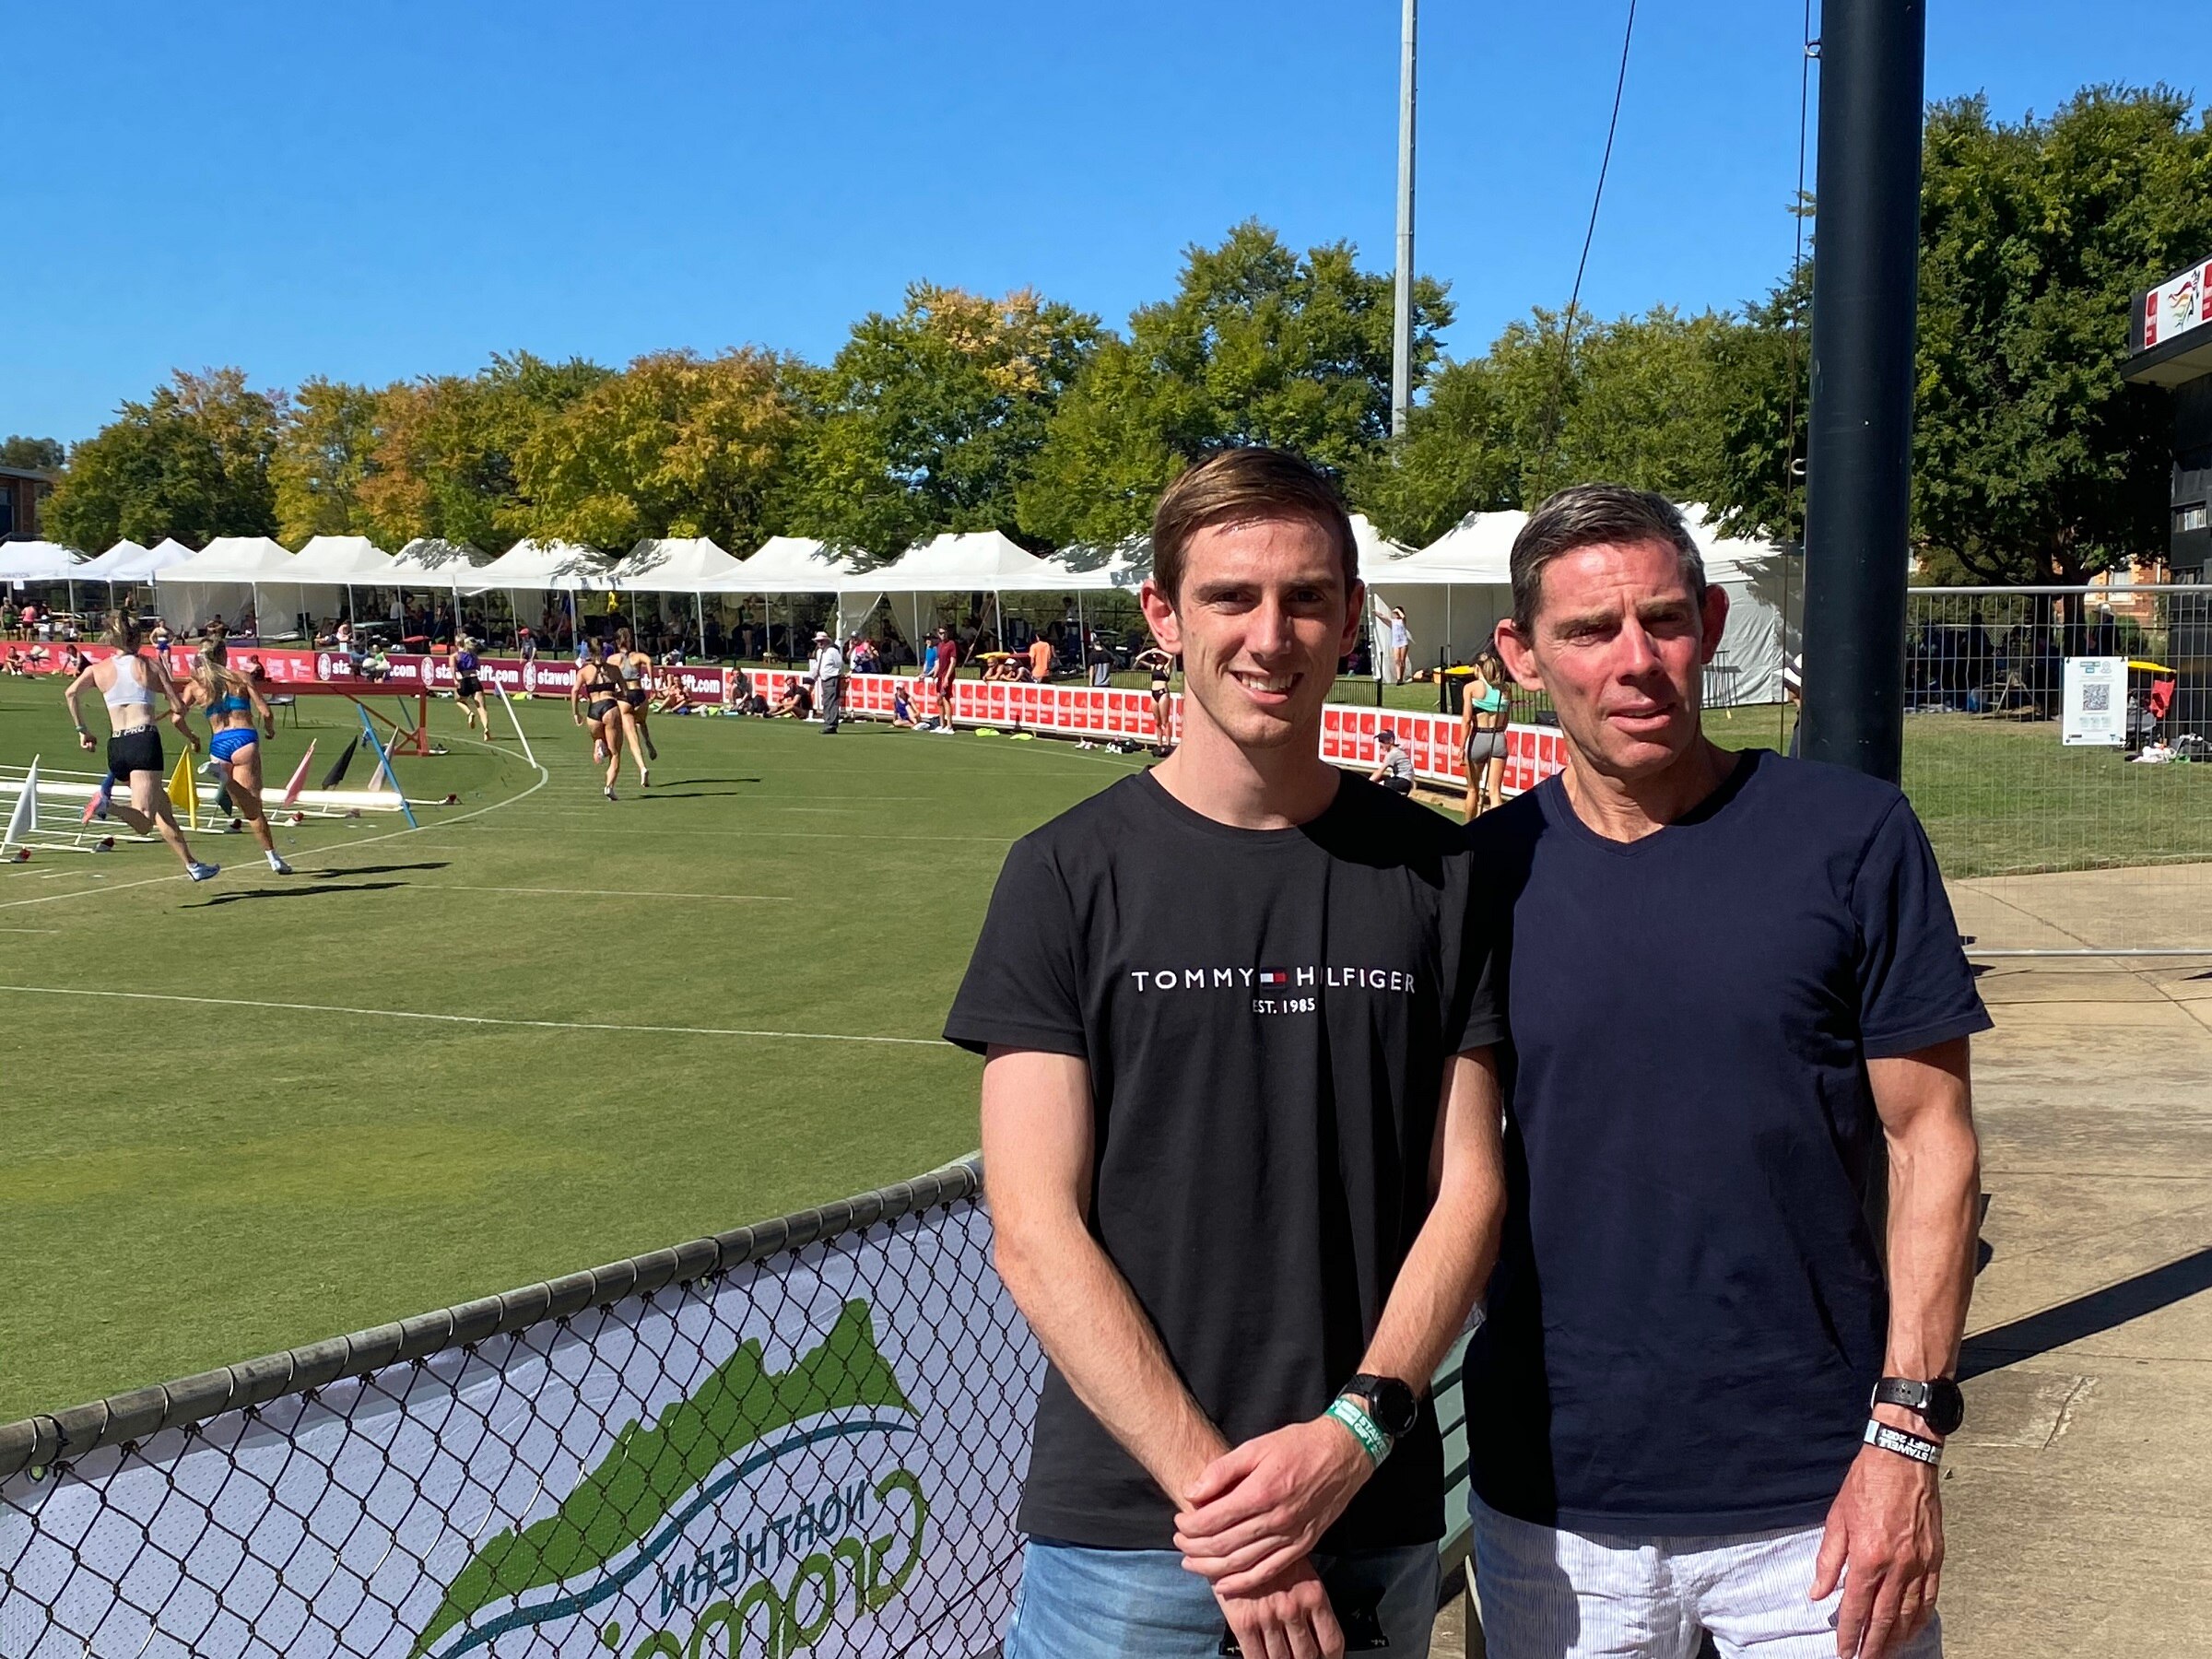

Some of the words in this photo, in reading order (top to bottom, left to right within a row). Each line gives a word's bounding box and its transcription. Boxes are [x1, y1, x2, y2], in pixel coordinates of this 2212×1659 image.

[1131, 968, 1254, 992] TOMMY
[1253, 999, 1277, 1014] EST.
[1283, 997, 1315, 1013] 1985
[1353, 1422, 1374, 1445] GIFT
[1878, 1436, 1929, 1462] STAWELL
[1907, 1438, 1931, 1453] GIFT
